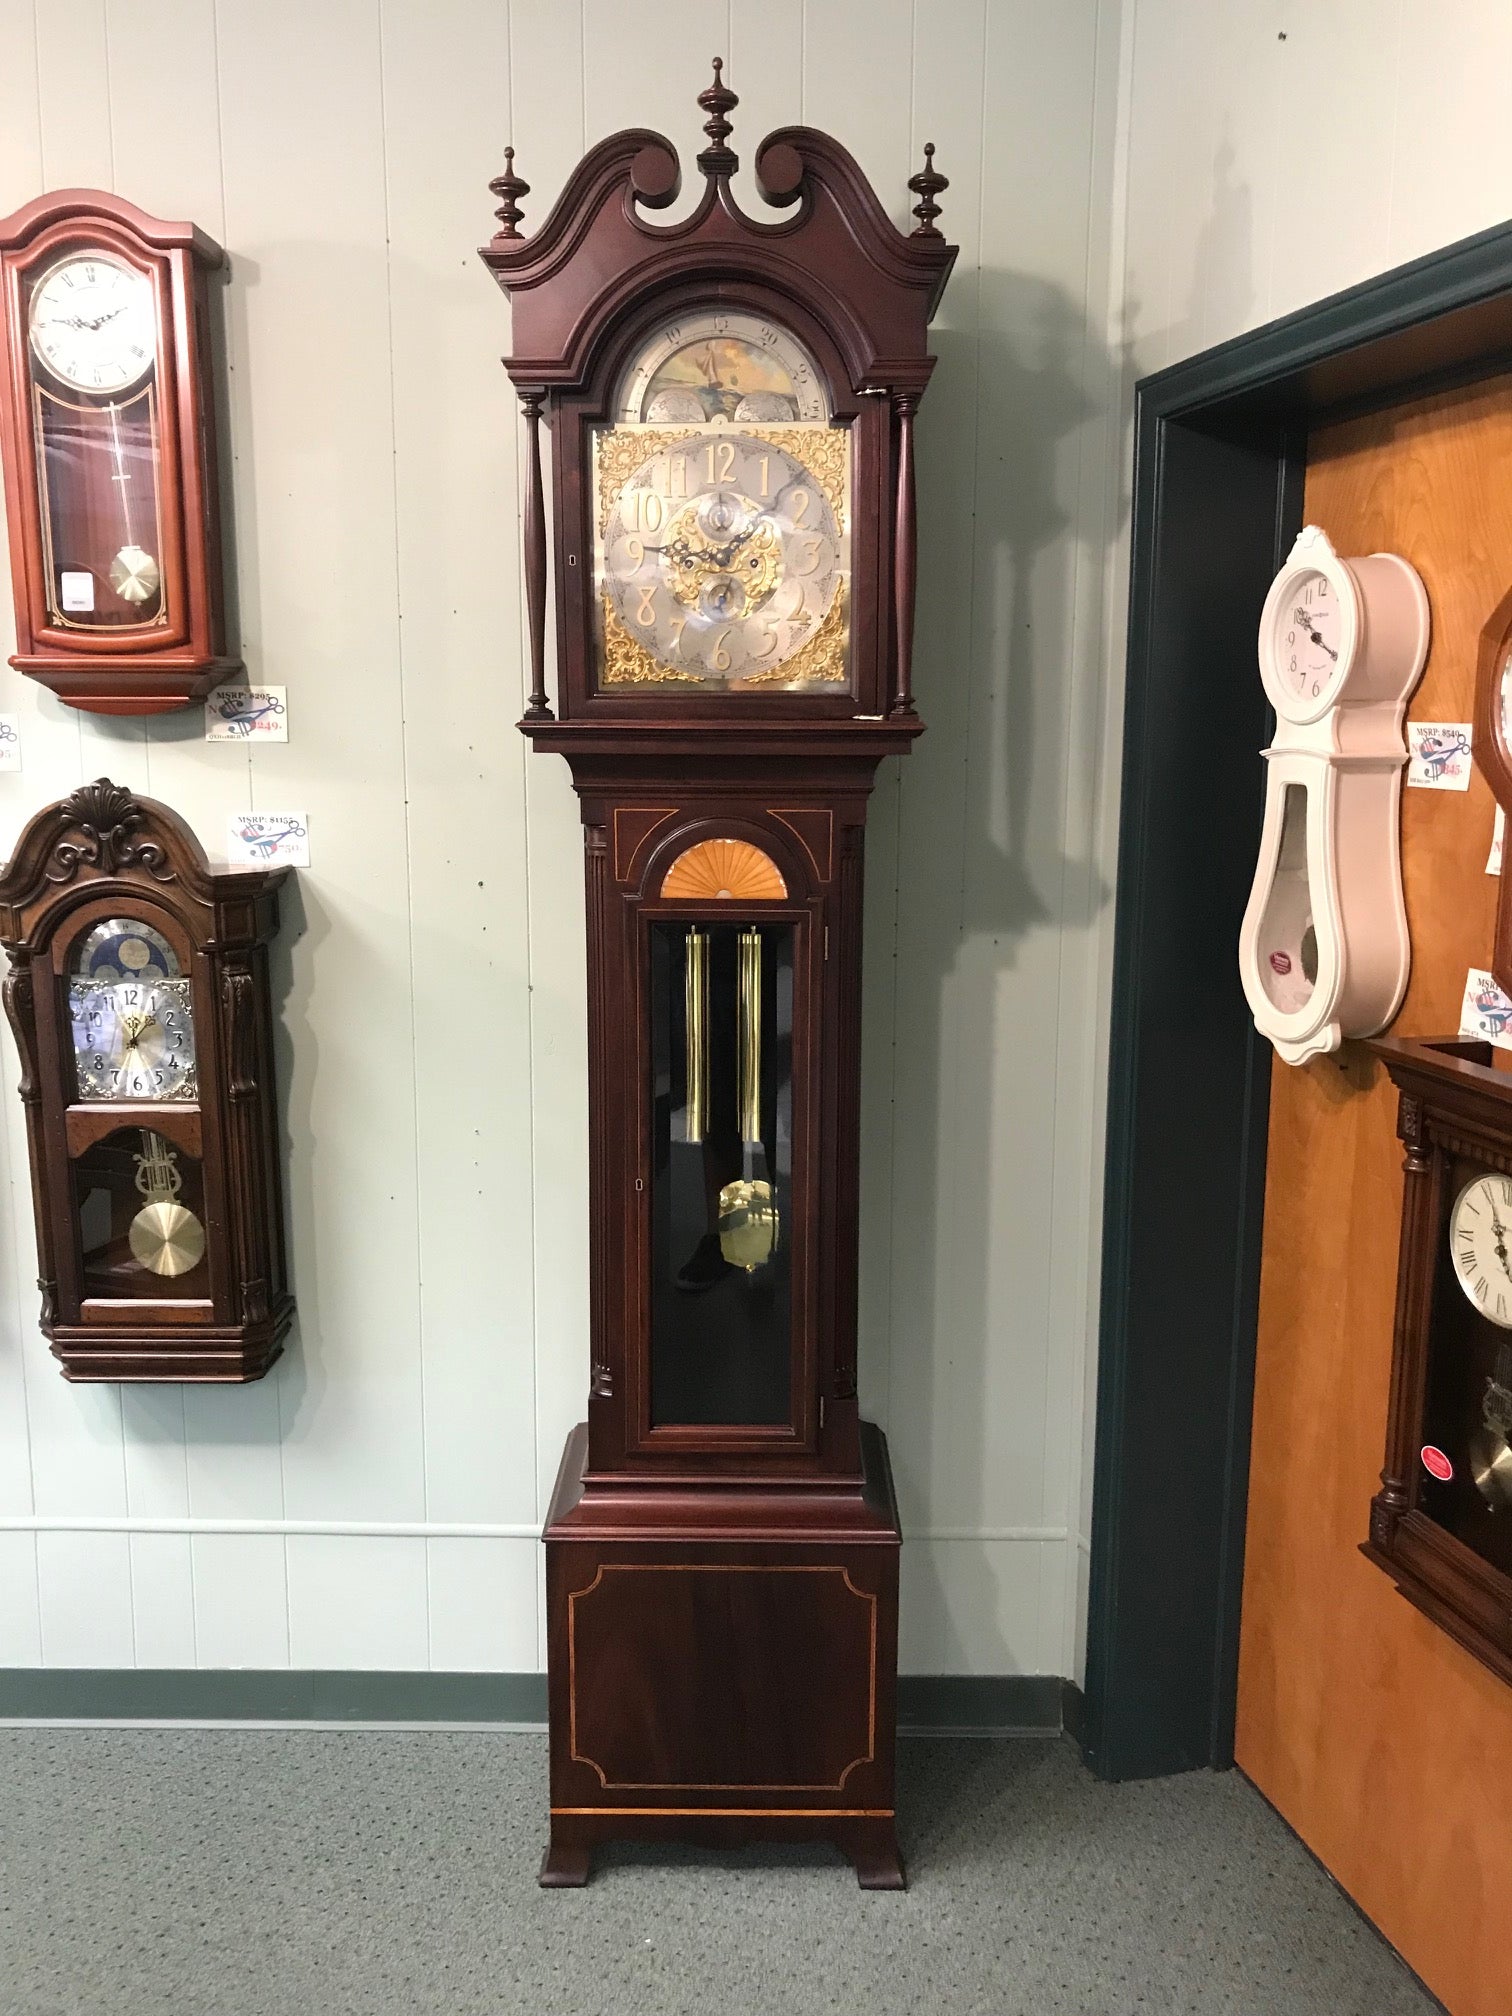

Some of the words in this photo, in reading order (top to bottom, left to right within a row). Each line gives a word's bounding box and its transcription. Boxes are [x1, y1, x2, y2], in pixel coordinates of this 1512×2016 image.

[664, 327, 681, 344] 10
[761, 327, 778, 346] 20
[705, 442, 736, 484] 12
[663, 456, 688, 498] 11
[760, 456, 769, 497] 1
[631, 492, 662, 533] 10
[793, 490, 810, 530] 2
[626, 540, 645, 577] 9
[798, 539, 824, 577] 3
[1318, 578, 1328, 596] 12
[787, 582, 812, 626] 4
[1305, 589, 1313, 605] 11
[637, 586, 656, 627] 8
[670, 616, 688, 657] 7
[757, 618, 781, 658] 5
[1288, 631, 1296, 648] 9
[713, 630, 731, 672] 6
[1290, 654, 1297, 672] 8
[1300, 672, 1307, 689] 7
[1312, 680, 1320, 697] 6
[216, 691, 246, 699] MSRP:
[1416, 728, 1439, 737] MSRP:
[103, 996, 115, 1011] 11
[124, 990, 138, 1005] 12
[150, 996, 156, 1011] 1
[88, 1011, 103, 1027] 10
[166, 1010, 175, 1027] 2
[86, 1033, 96, 1048] 9
[172, 1030, 183, 1048] 3
[94, 1054, 104, 1070] 8
[168, 1054, 179, 1069] 4
[110, 1068, 120, 1085] 7
[133, 1076, 142, 1091] 6
[155, 1068, 164, 1085] 5
